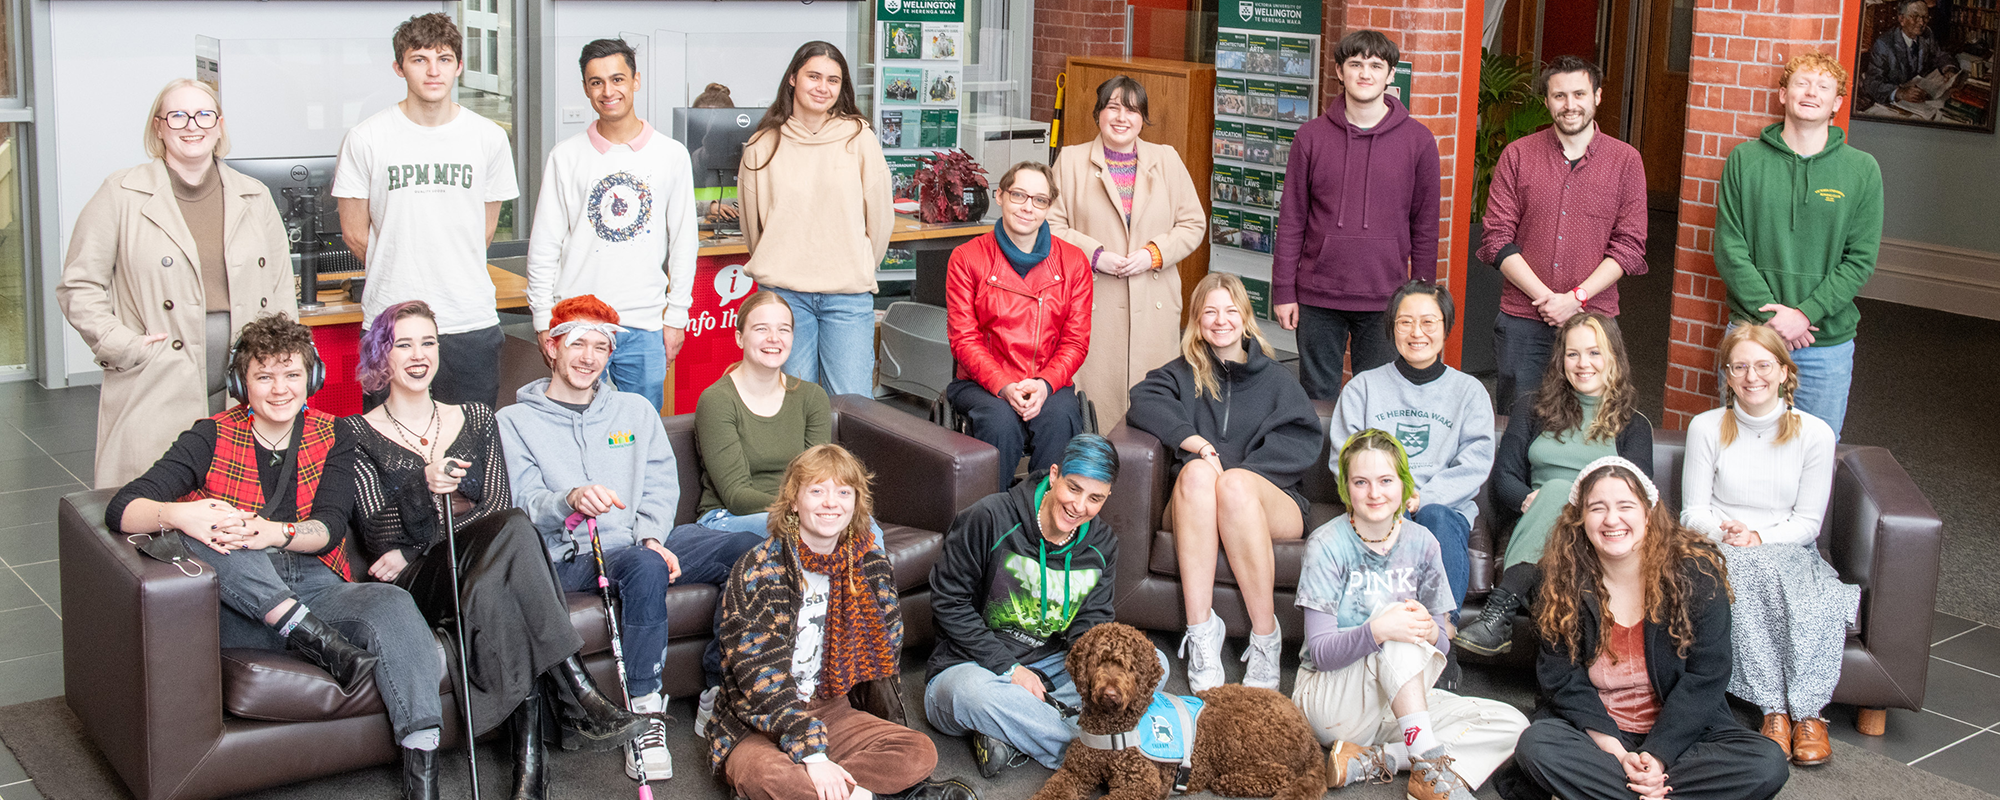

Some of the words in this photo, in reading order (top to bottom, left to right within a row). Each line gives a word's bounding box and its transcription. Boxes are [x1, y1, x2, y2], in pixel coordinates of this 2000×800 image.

[903, 1, 956, 9] WELLINGTON
[1254, 8, 1302, 18] WELLINGTON
[1249, 45, 1264, 53] ARTS
[1215, 130, 1243, 138] EDUCATION
[387, 164, 430, 191] RPM
[433, 163, 473, 189] MFG
[1214, 174, 1234, 183] HEALTH
[1244, 180, 1260, 188] LAWS
[1212, 218, 1229, 226] MUSIC
[1243, 222, 1264, 232] SCIENCE
[686, 311, 716, 337] nfo
[720, 308, 738, 328] Ih
[1375, 413, 1386, 421] TE
[1386, 409, 1429, 418] HERENGA
[1431, 412, 1454, 429] WAKA
[1345, 567, 1417, 595] PINK
